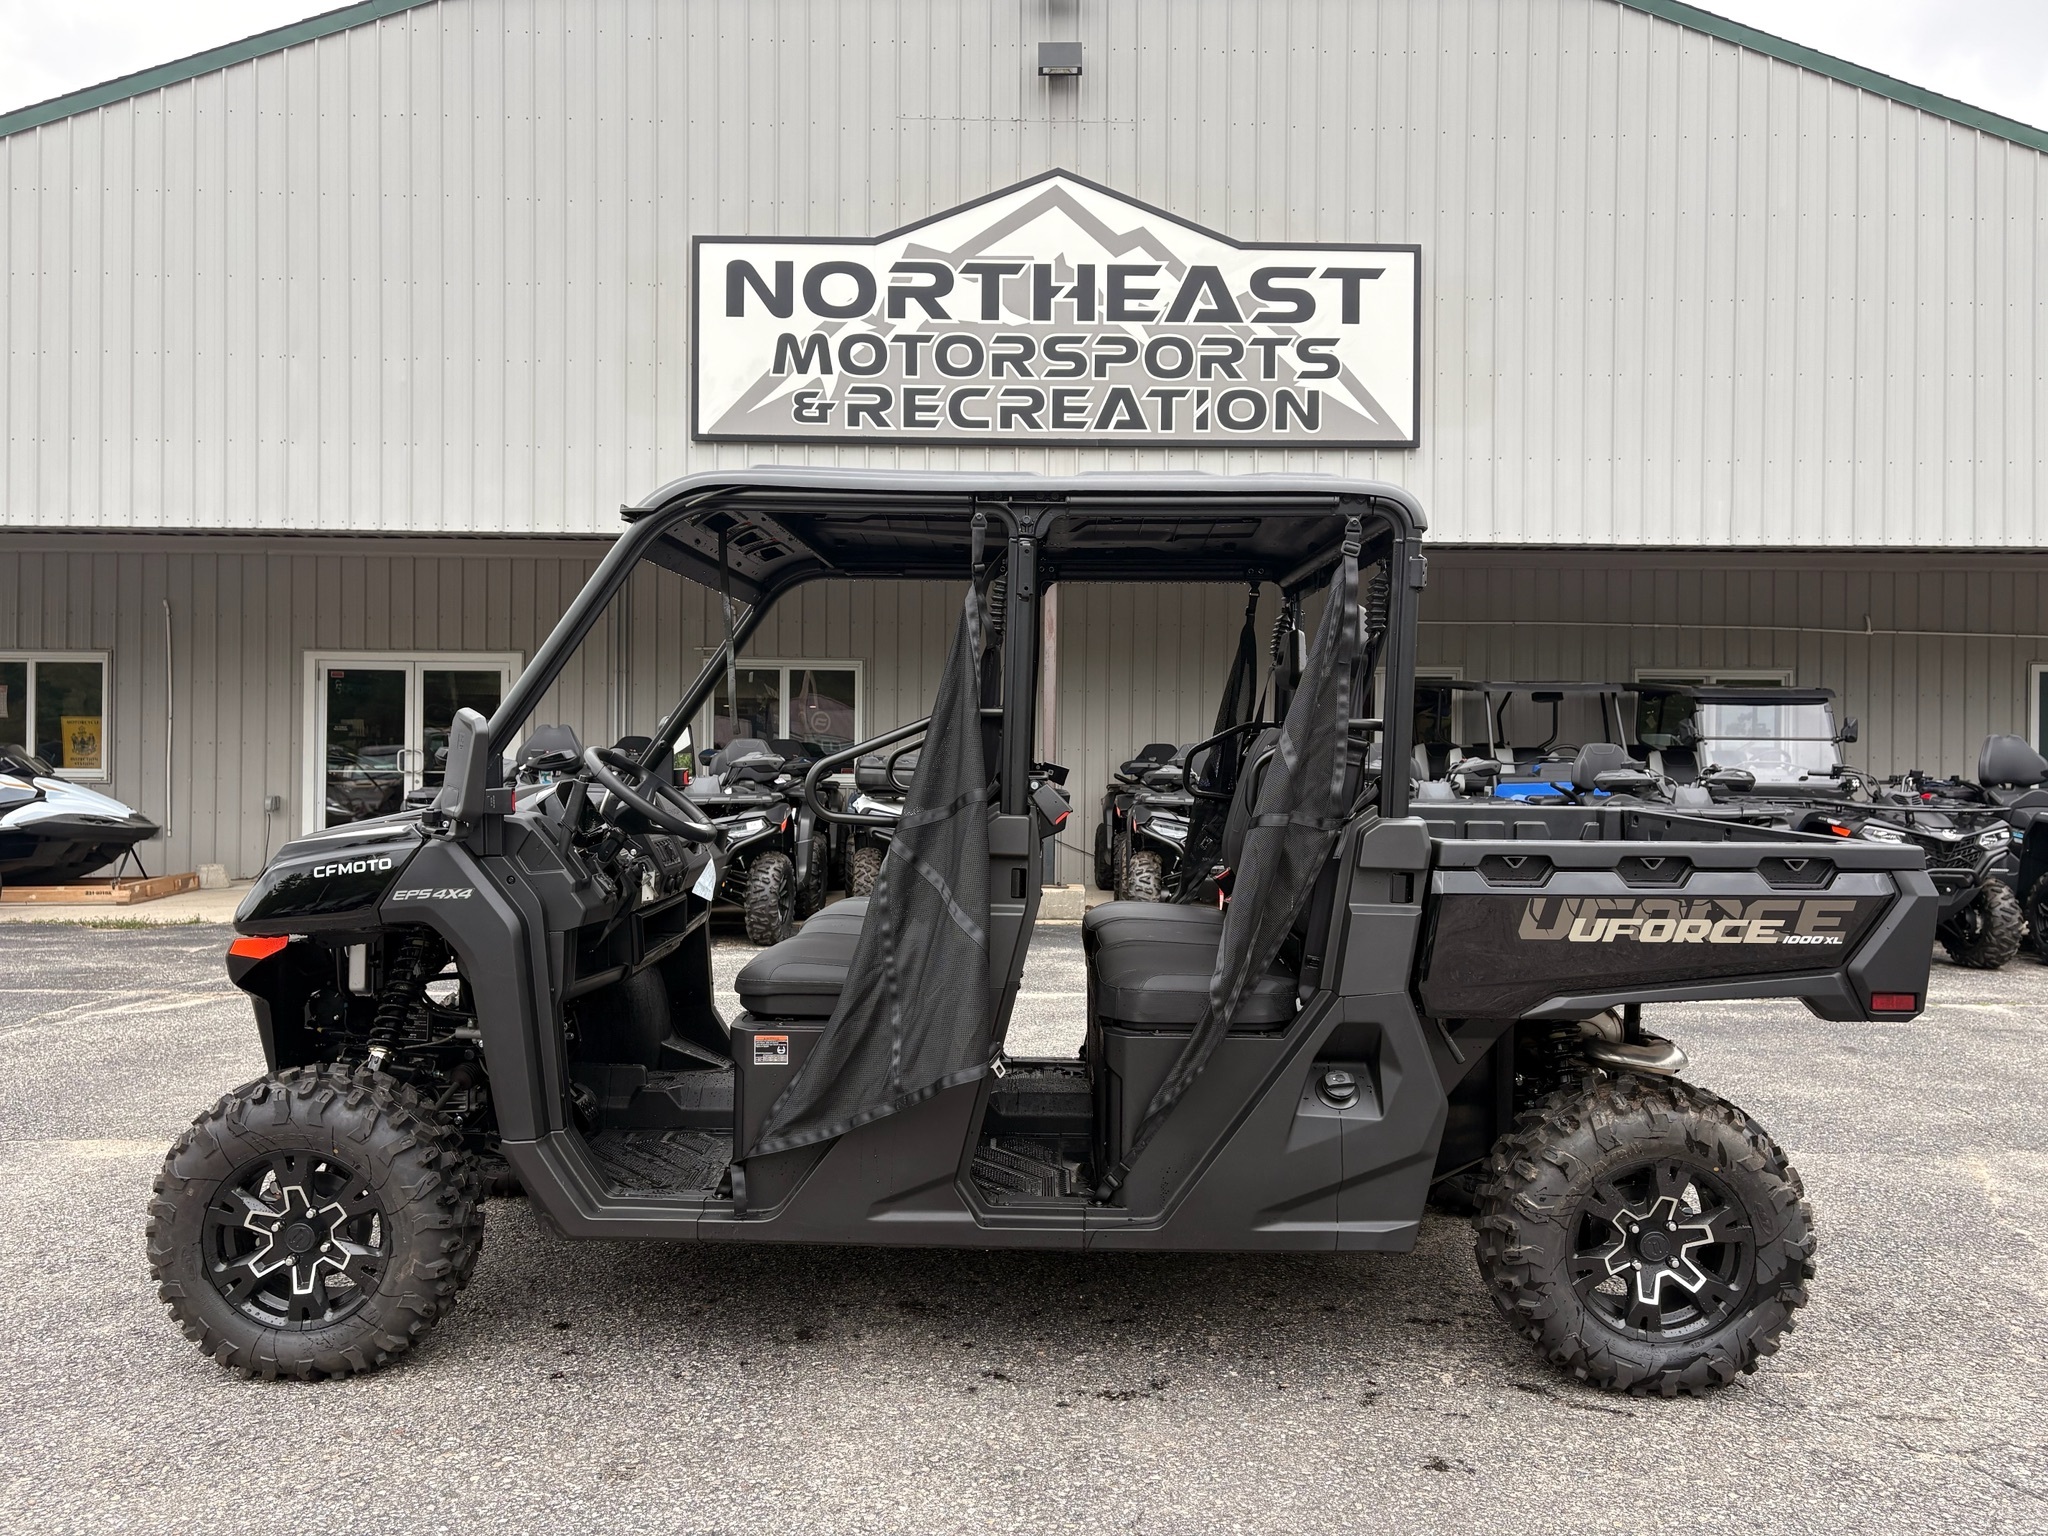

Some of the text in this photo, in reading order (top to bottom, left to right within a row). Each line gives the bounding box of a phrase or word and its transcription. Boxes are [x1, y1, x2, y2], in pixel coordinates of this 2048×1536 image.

[725, 259, 1386, 325] NORTHEAST
[771, 332, 1341, 380] MOTORSPORTS
[792, 385, 1320, 431] & RECREATION
[313, 857, 392, 878] CFMOTO
[392, 888, 433, 901] EPS
[1568, 918, 1786, 944] UFORCE
[1782, 935, 1843, 945] 1000 XL
